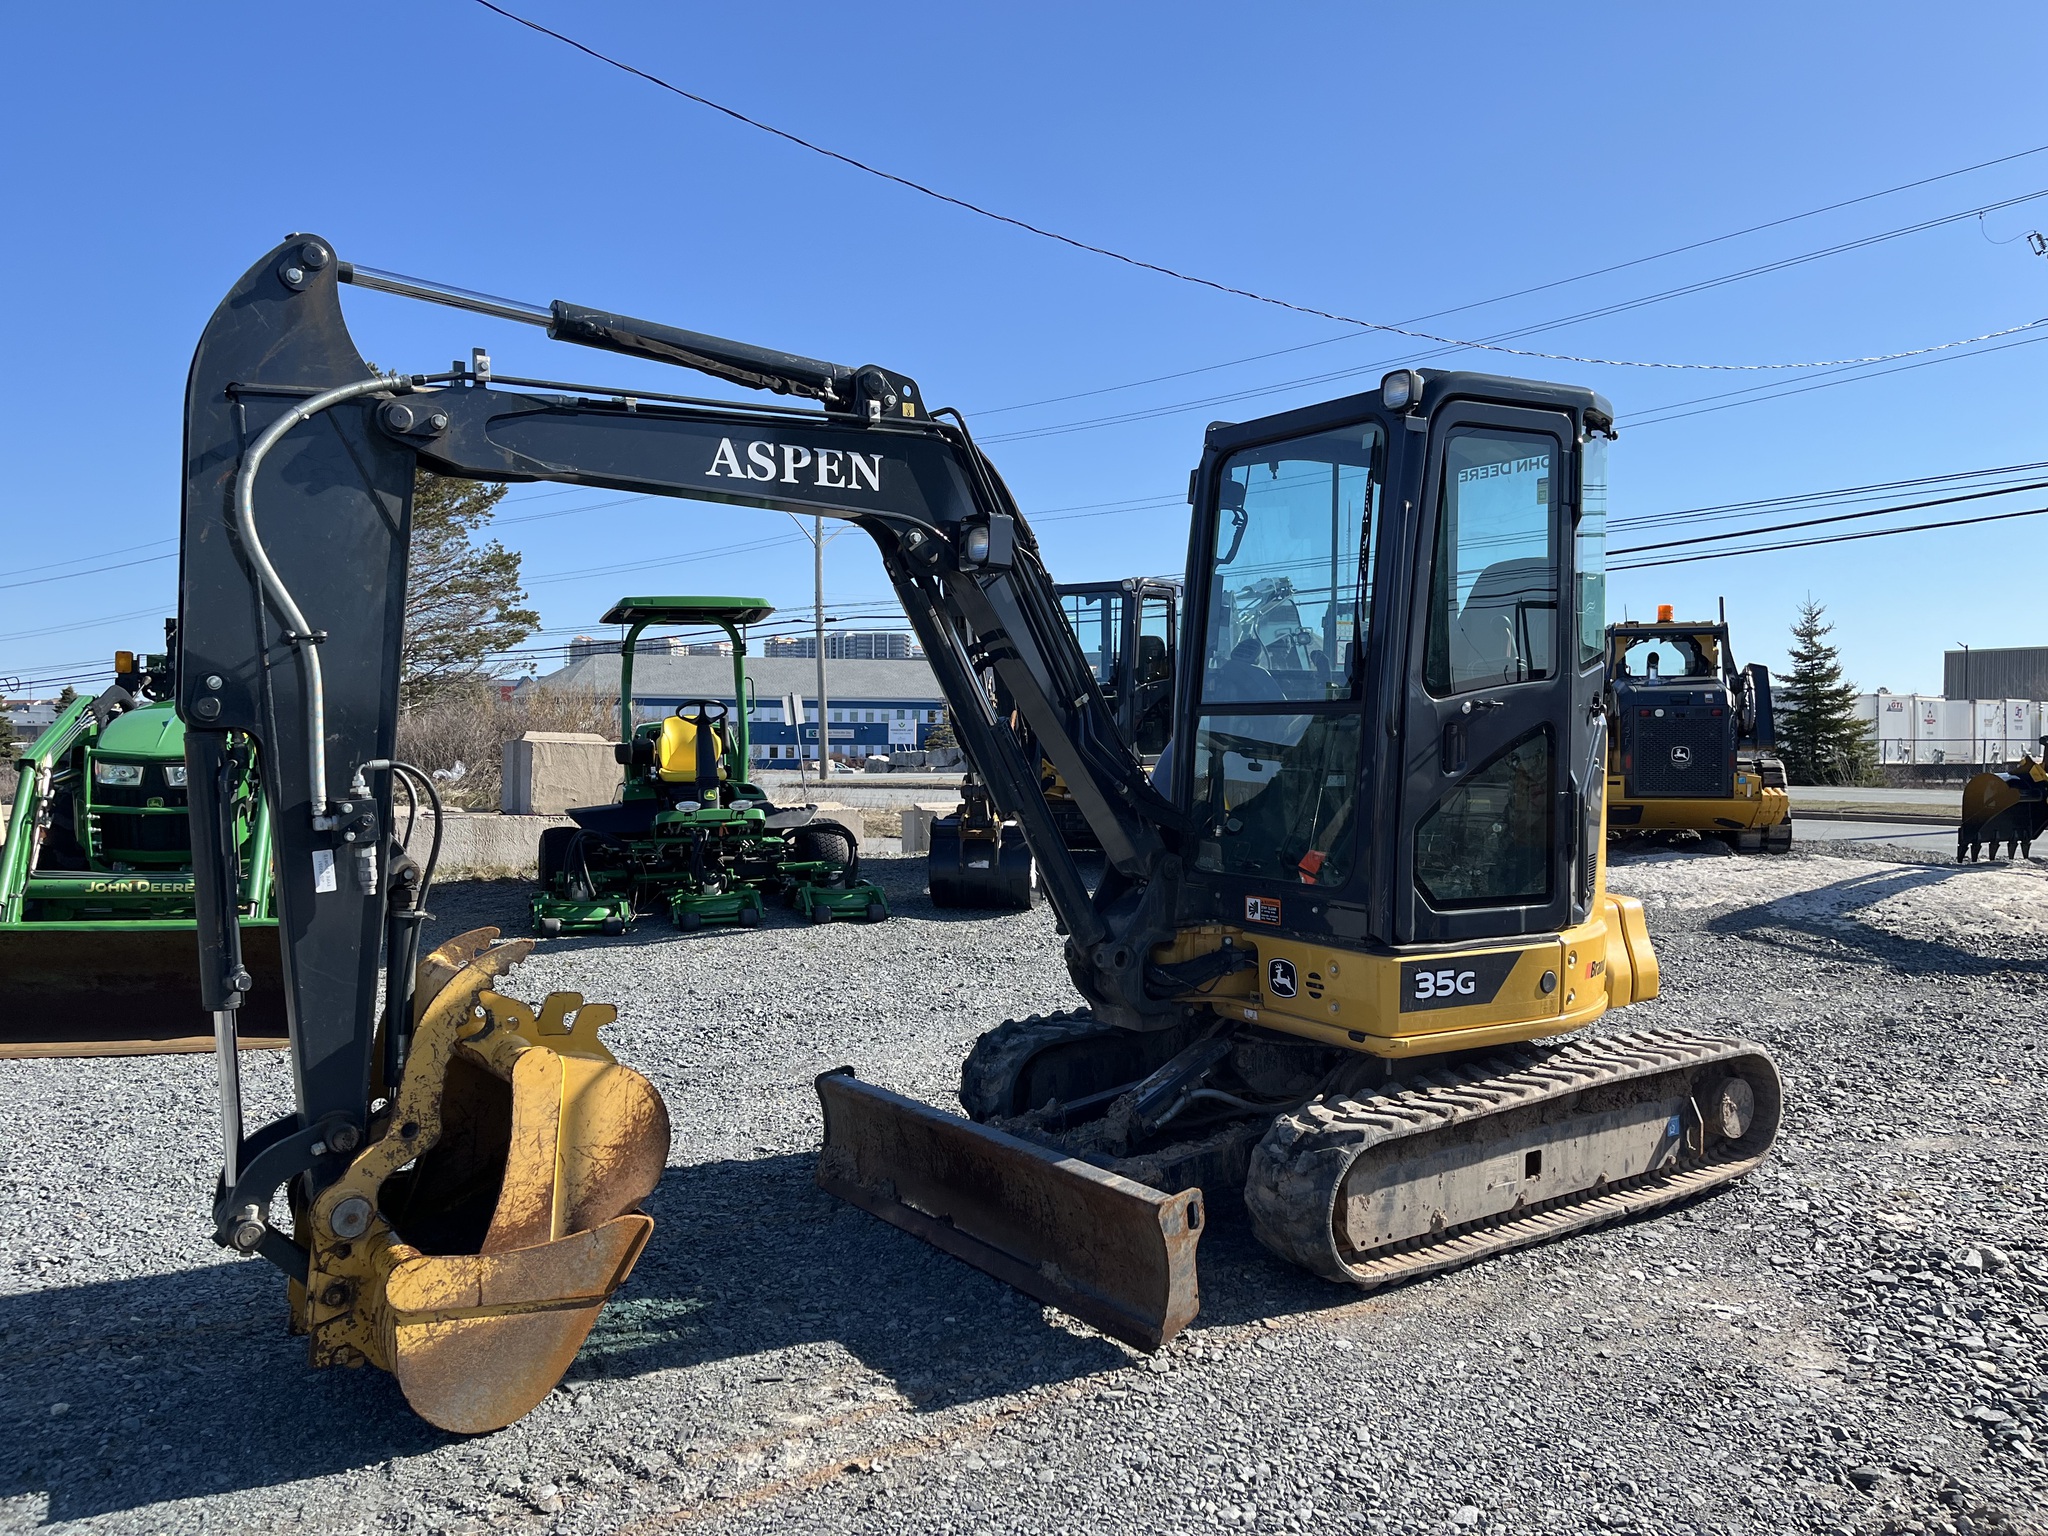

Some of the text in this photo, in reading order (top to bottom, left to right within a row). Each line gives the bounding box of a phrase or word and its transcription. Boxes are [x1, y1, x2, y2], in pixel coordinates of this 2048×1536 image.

[705, 437, 884, 492] ASPEN
[85, 881, 196, 893] JOHN DEERE
[1414, 969, 1476, 1000] 35G
